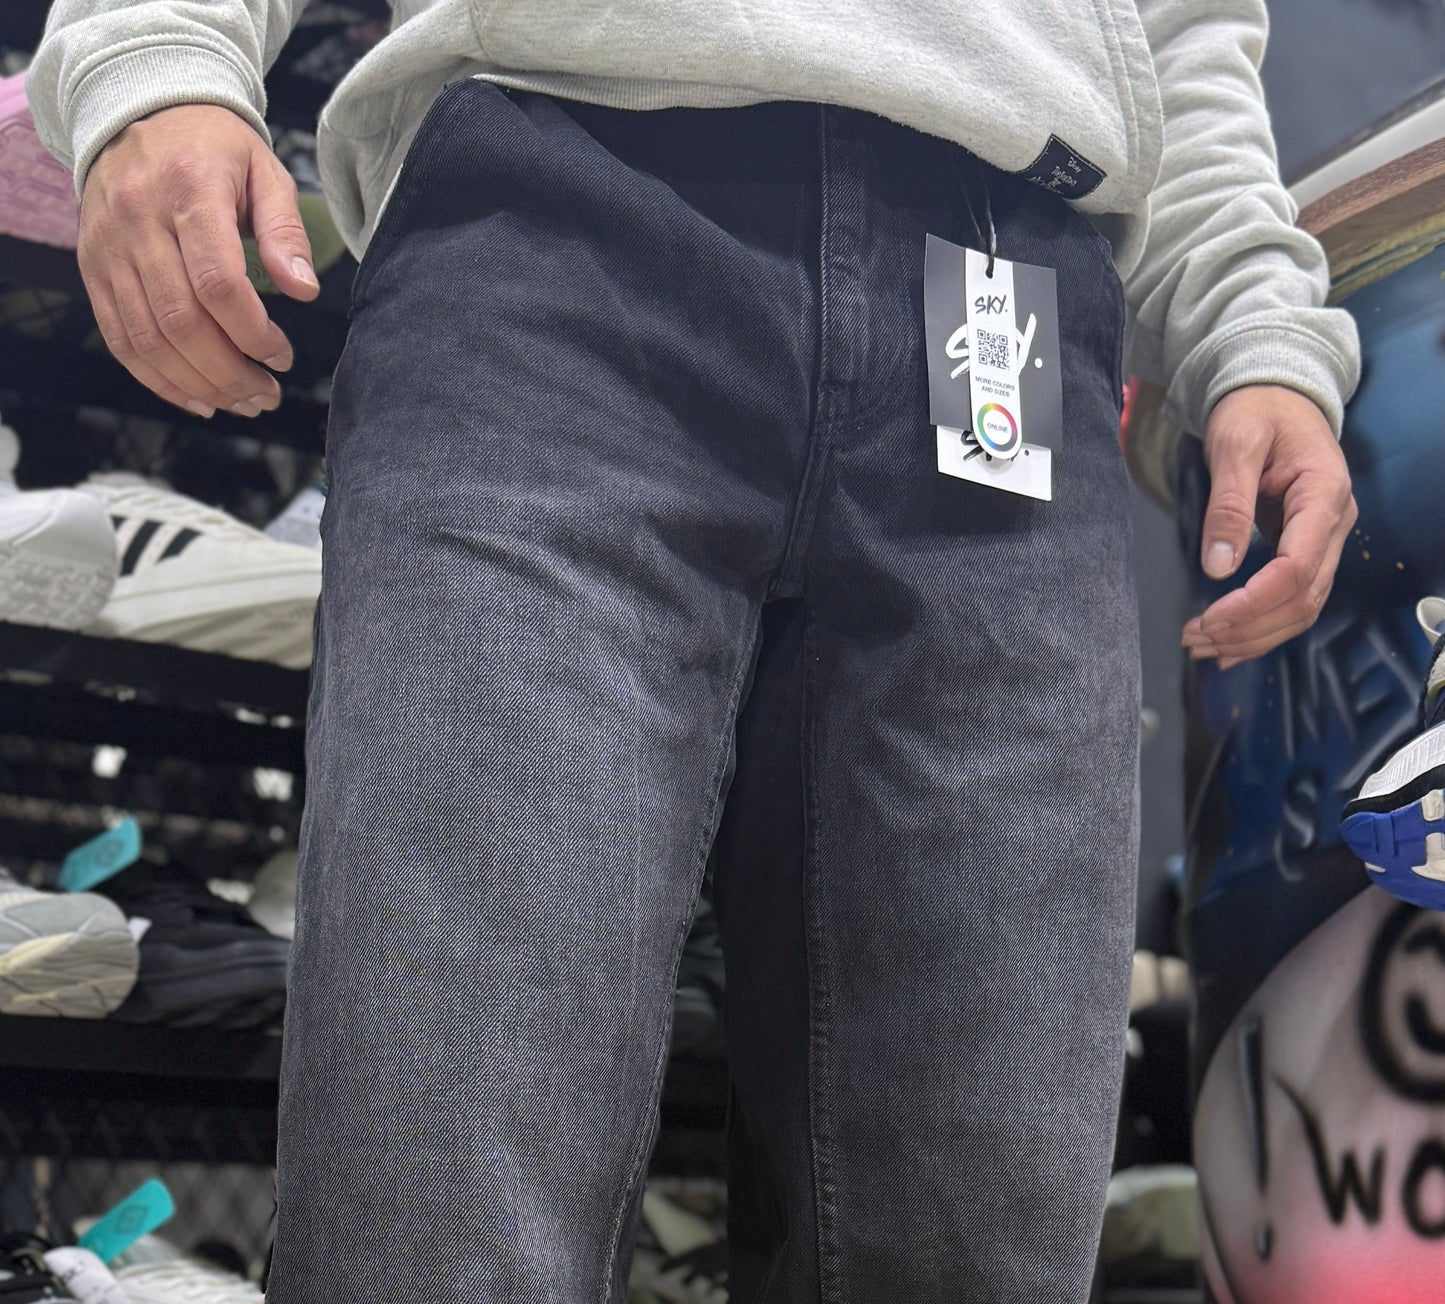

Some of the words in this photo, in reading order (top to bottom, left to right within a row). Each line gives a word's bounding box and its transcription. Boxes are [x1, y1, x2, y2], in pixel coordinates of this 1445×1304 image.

[975, 376, 992, 385] MORE
[992, 380, 1016, 391] COLORS
[981, 385, 993, 393] AND
[994, 388, 1010, 398] SIZES
[987, 422, 1009, 434] ONLINE
